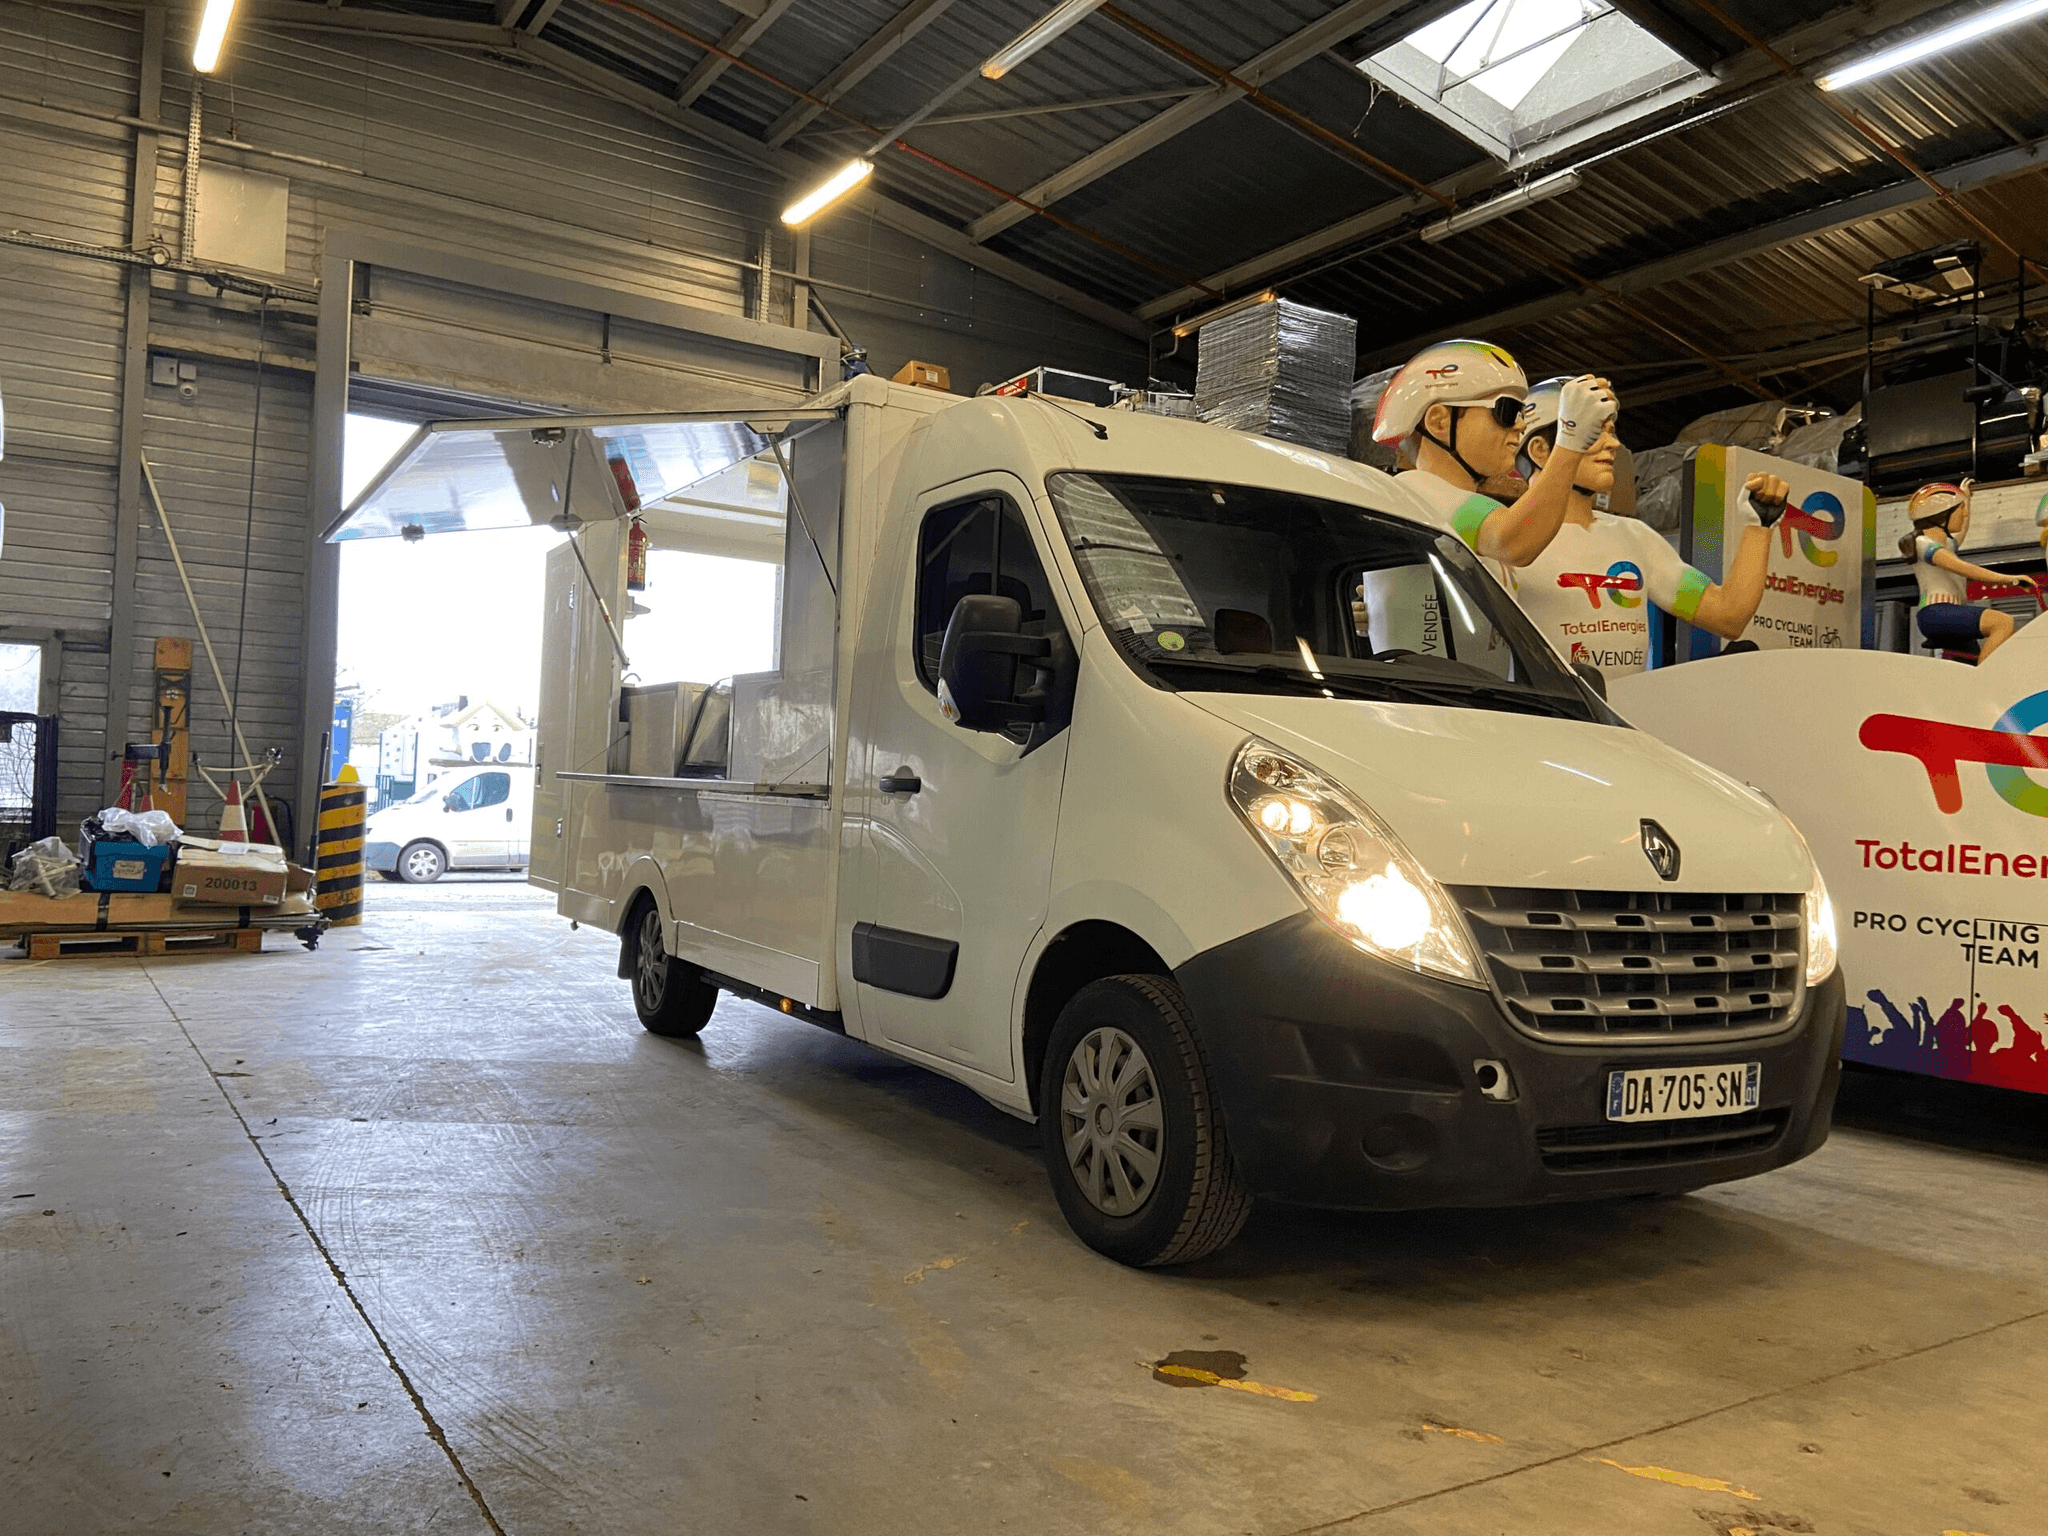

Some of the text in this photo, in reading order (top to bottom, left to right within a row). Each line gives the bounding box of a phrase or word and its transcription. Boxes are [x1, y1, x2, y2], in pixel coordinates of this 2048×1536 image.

[1765, 572, 1845, 605] otalEnergies
[1421, 594, 1439, 653] VENDÉE
[1560, 620, 1647, 635] TotalEnergies
[1754, 615, 1813, 635] PRO CYCLING
[1789, 635, 1813, 648] TEAM
[1592, 647, 1643, 666] VENDÉE
[205, 877, 257, 891] 200013
[1853, 911, 2040, 944] PRO CYCLING
[1960, 943, 2039, 969] TEAM
